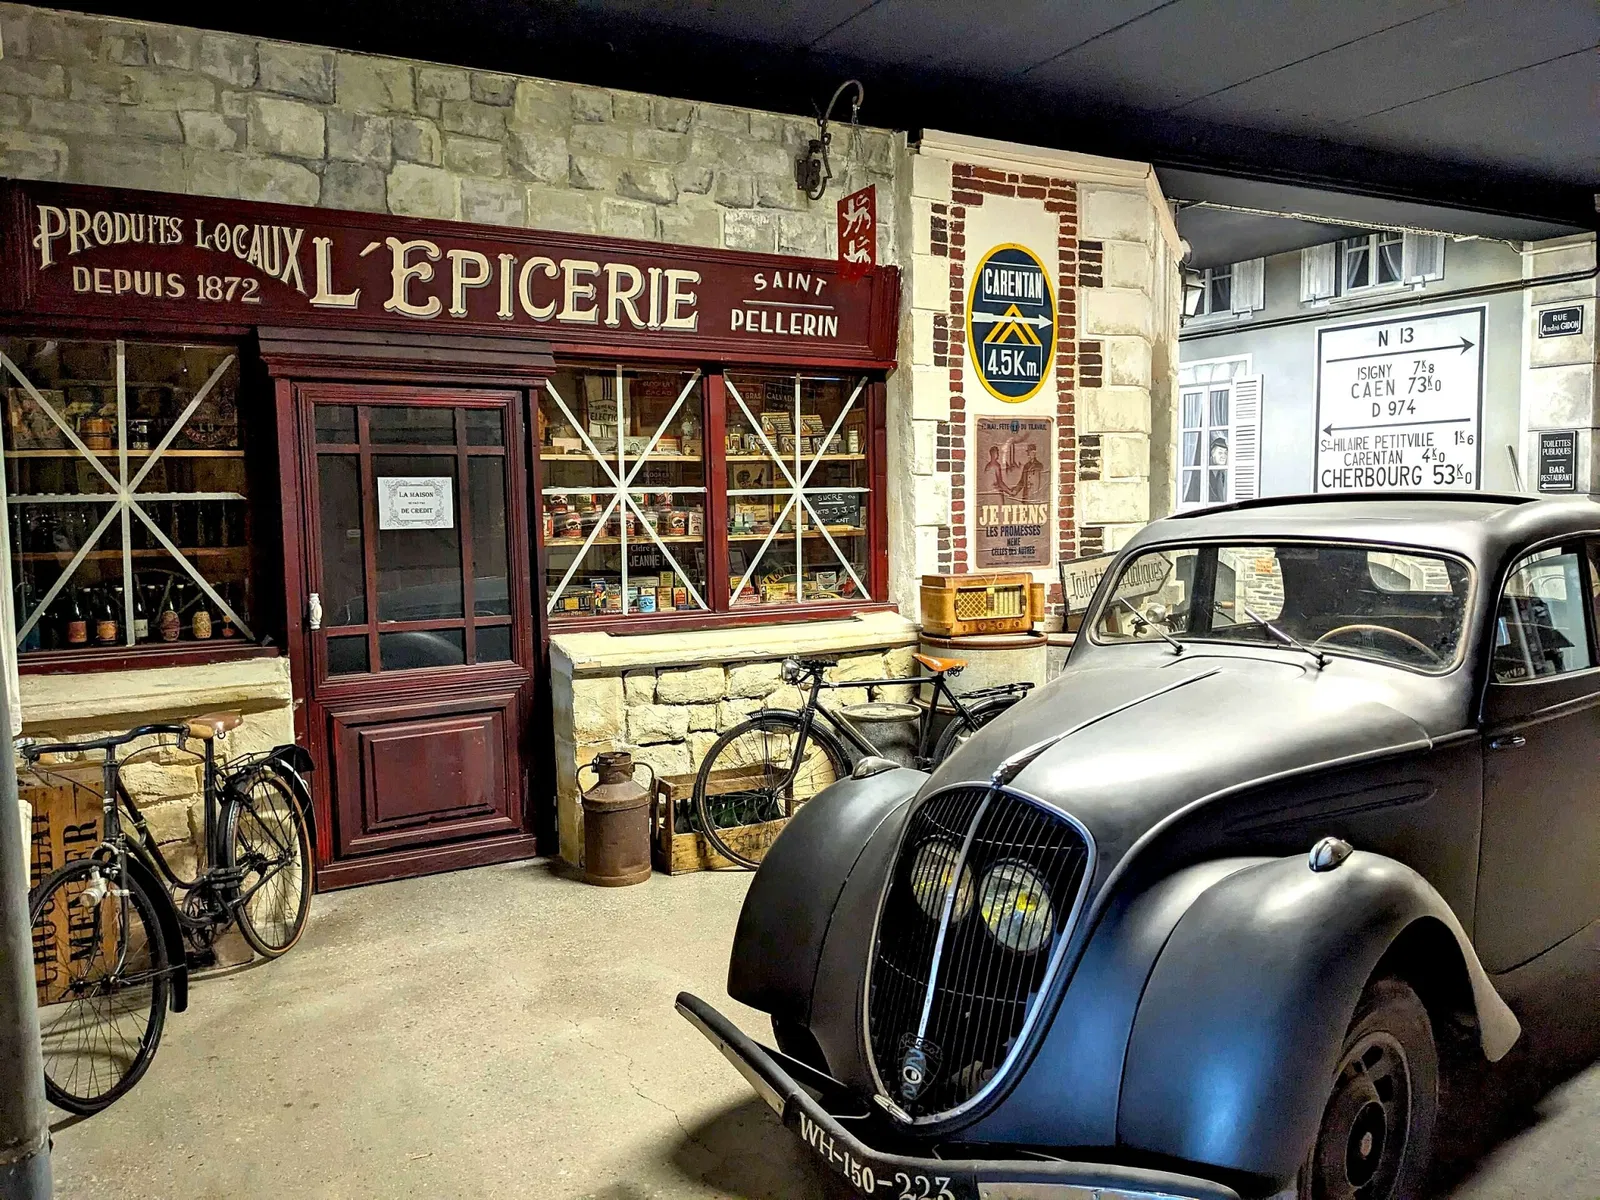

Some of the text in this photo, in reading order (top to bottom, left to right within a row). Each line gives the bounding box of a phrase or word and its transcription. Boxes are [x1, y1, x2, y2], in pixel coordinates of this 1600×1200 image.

[33, 204, 306, 295] PRODUITS LOCAUX
[72, 266, 261, 304] DEPUIS 1872
[754, 271, 828, 298] SAINT
[984, 268, 1043, 299] CARENTAN
[730, 308, 838, 338] PELLERIN
[1552, 313, 1568, 322] RUE
[1560, 320, 1579, 330] GIDON
[1378, 327, 1415, 347] N 13
[1357, 363, 1393, 381] ISIGNY
[766, 391, 798, 402] CALVAD
[1351, 379, 1395, 399] CAEN
[1372, 399, 1416, 418] D 974
[1374, 431, 1435, 450] PETITVILLE
[1543, 439, 1571, 448] TOILETTES
[1343, 450, 1403, 467] CARENTAN
[1542, 447, 1572, 456] PUBLIQUES
[1321, 465, 1423, 489] CHERBOURG
[1540, 473, 1572, 482] RESTAURANT
[1548, 465, 1565, 474] BAR
[817, 493, 843, 502] SUCRE
[979, 503, 1048, 526] JE TIENS
[985, 524, 1041, 538] LES PROMESSES
[991, 547, 1008, 557] CELLES
[1018, 545, 1035, 555] AUTRES
[629, 554, 661, 568] JEANNE
[579, 596, 590, 607] LU
